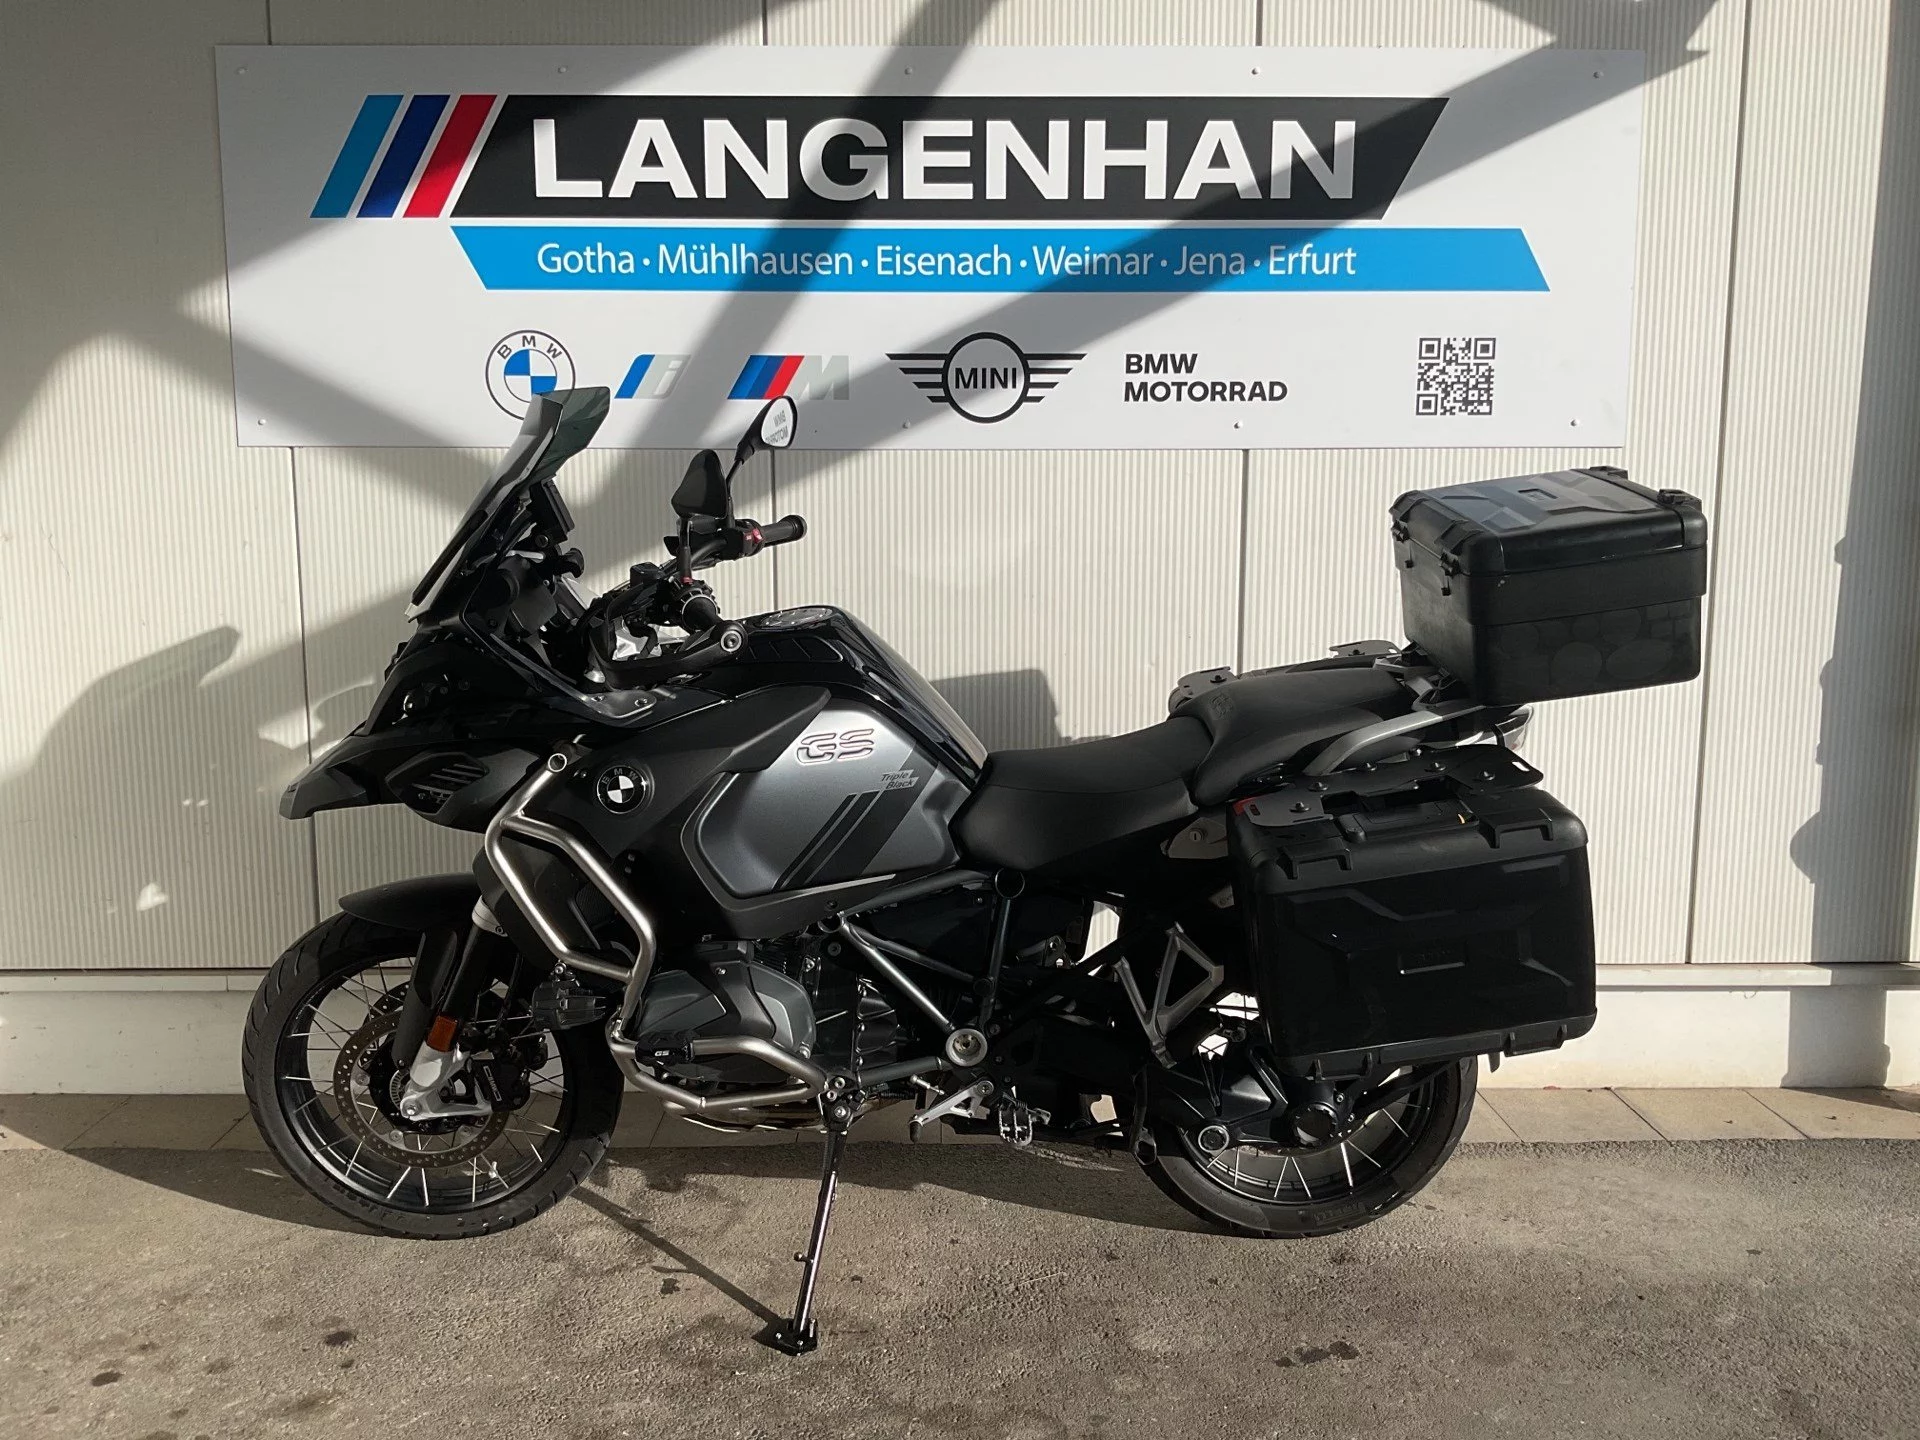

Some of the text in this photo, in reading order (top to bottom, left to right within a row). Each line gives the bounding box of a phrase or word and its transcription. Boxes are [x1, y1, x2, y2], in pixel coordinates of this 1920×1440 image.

[534, 118, 1356, 201] LANGENHAN
[537, 243, 1357, 277] Gotha Mühlhausen Eisenach Weimar Jena Erfurt
[497, 335, 563, 360] BMW
[1125, 353, 1198, 374] BMW
[954, 366, 1018, 391] MINI
[1124, 381, 1288, 403] MOTORRAD
[796, 727, 875, 765] GS
[600, 768, 639, 785] BMW
[880, 771, 911, 782] Triple
[885, 779, 914, 790] Black
[654, 1049, 670, 1057] GS
